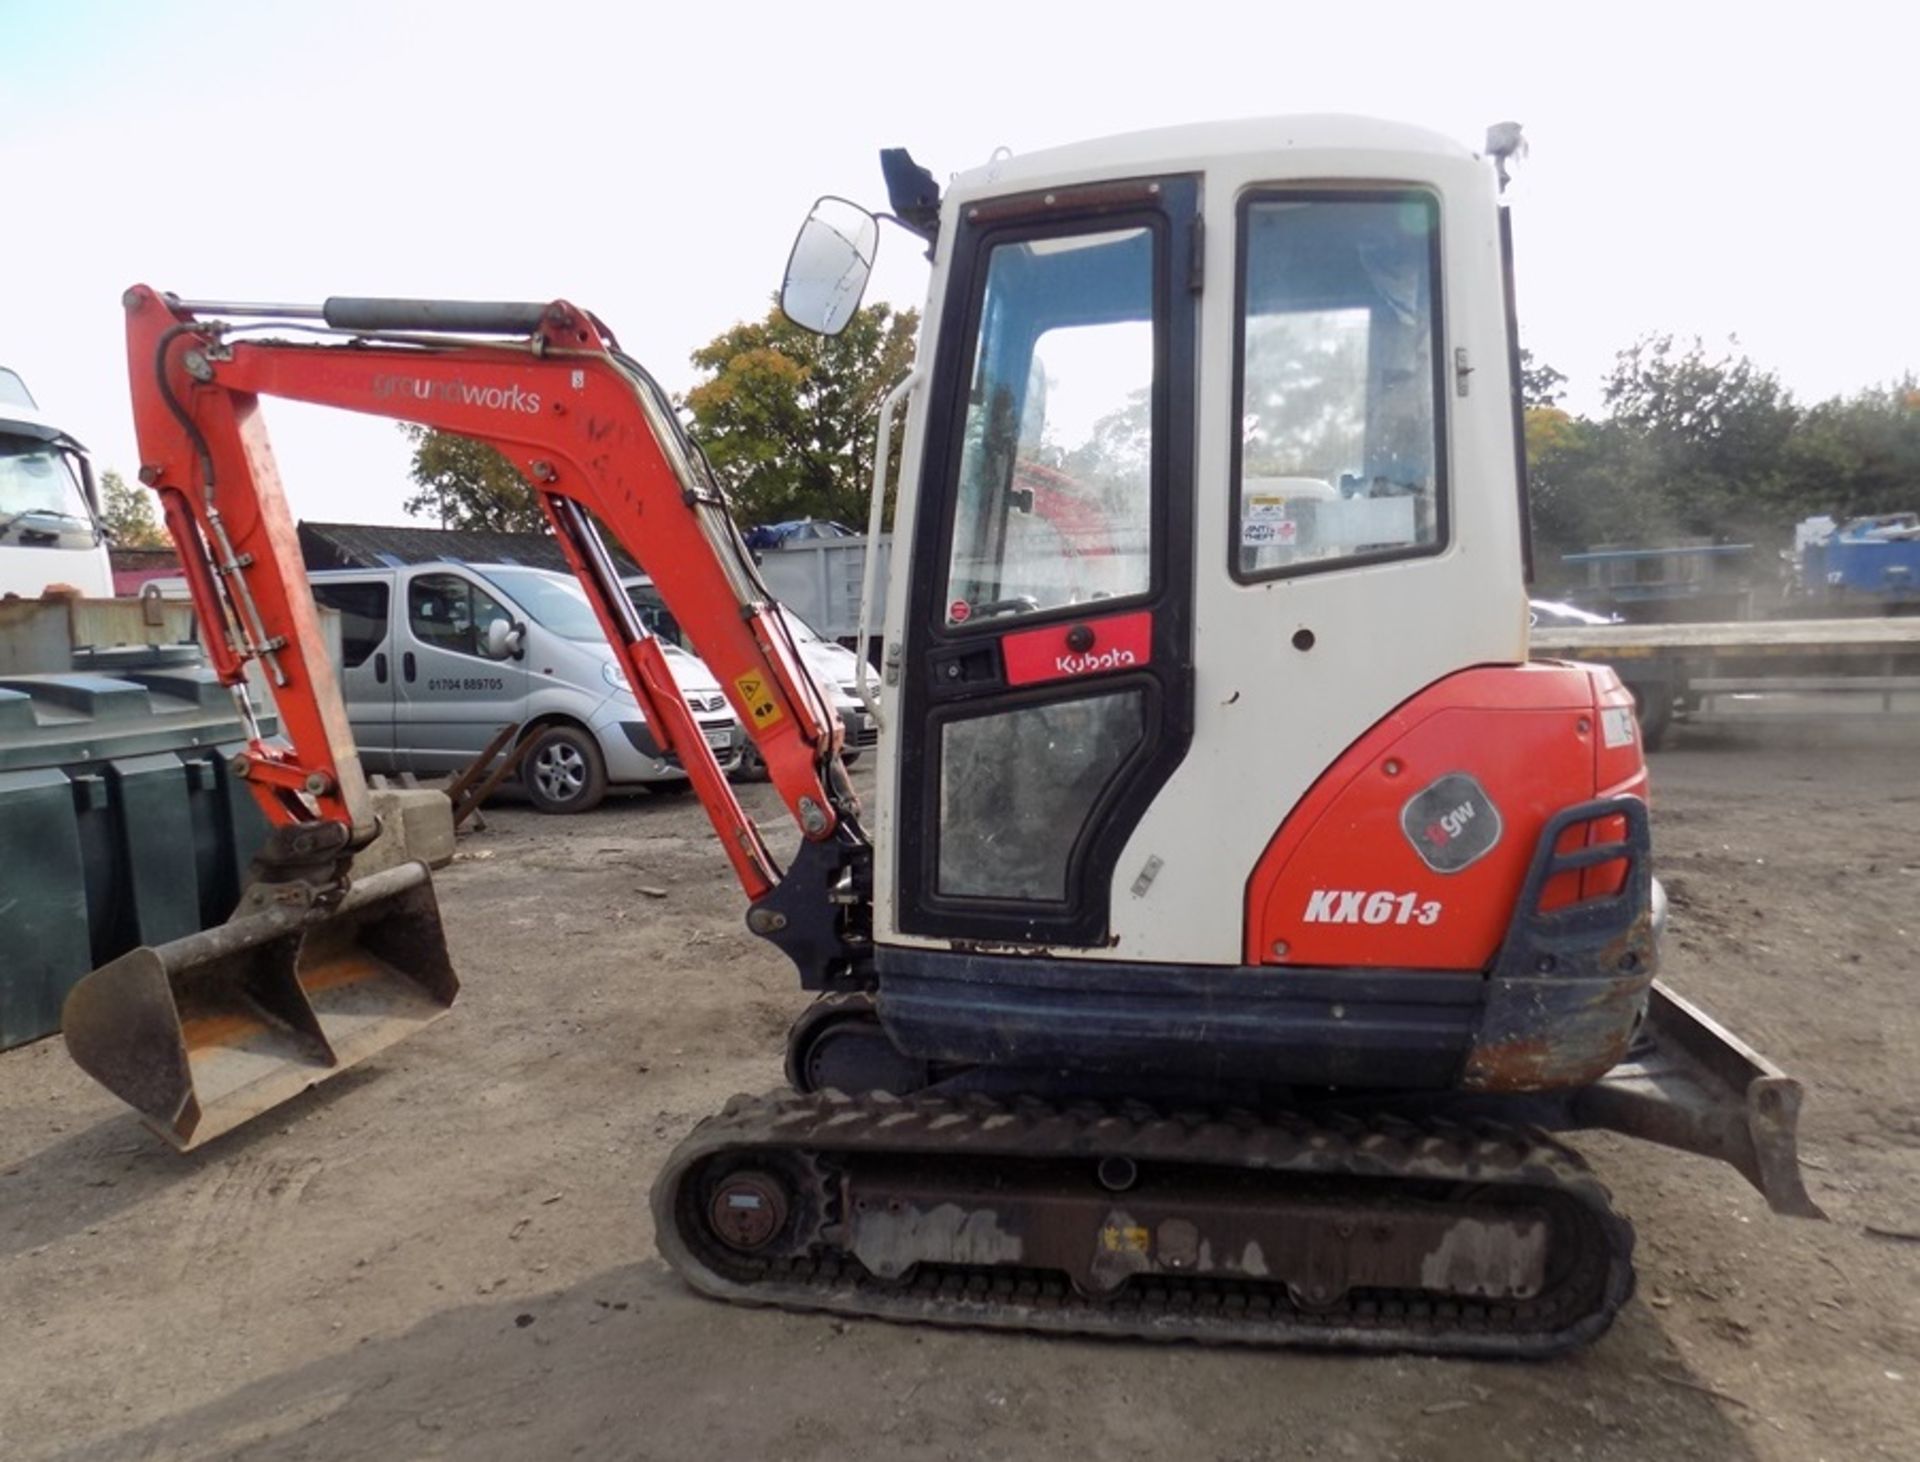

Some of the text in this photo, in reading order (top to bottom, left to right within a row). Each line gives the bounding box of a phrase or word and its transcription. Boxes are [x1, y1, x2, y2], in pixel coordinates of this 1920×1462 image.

[374, 374, 541, 414] groundworks
[1056, 647, 1136, 675] Kubota
[428, 679, 460, 691] 01704
[1303, 889, 1442, 926] KX61-3
